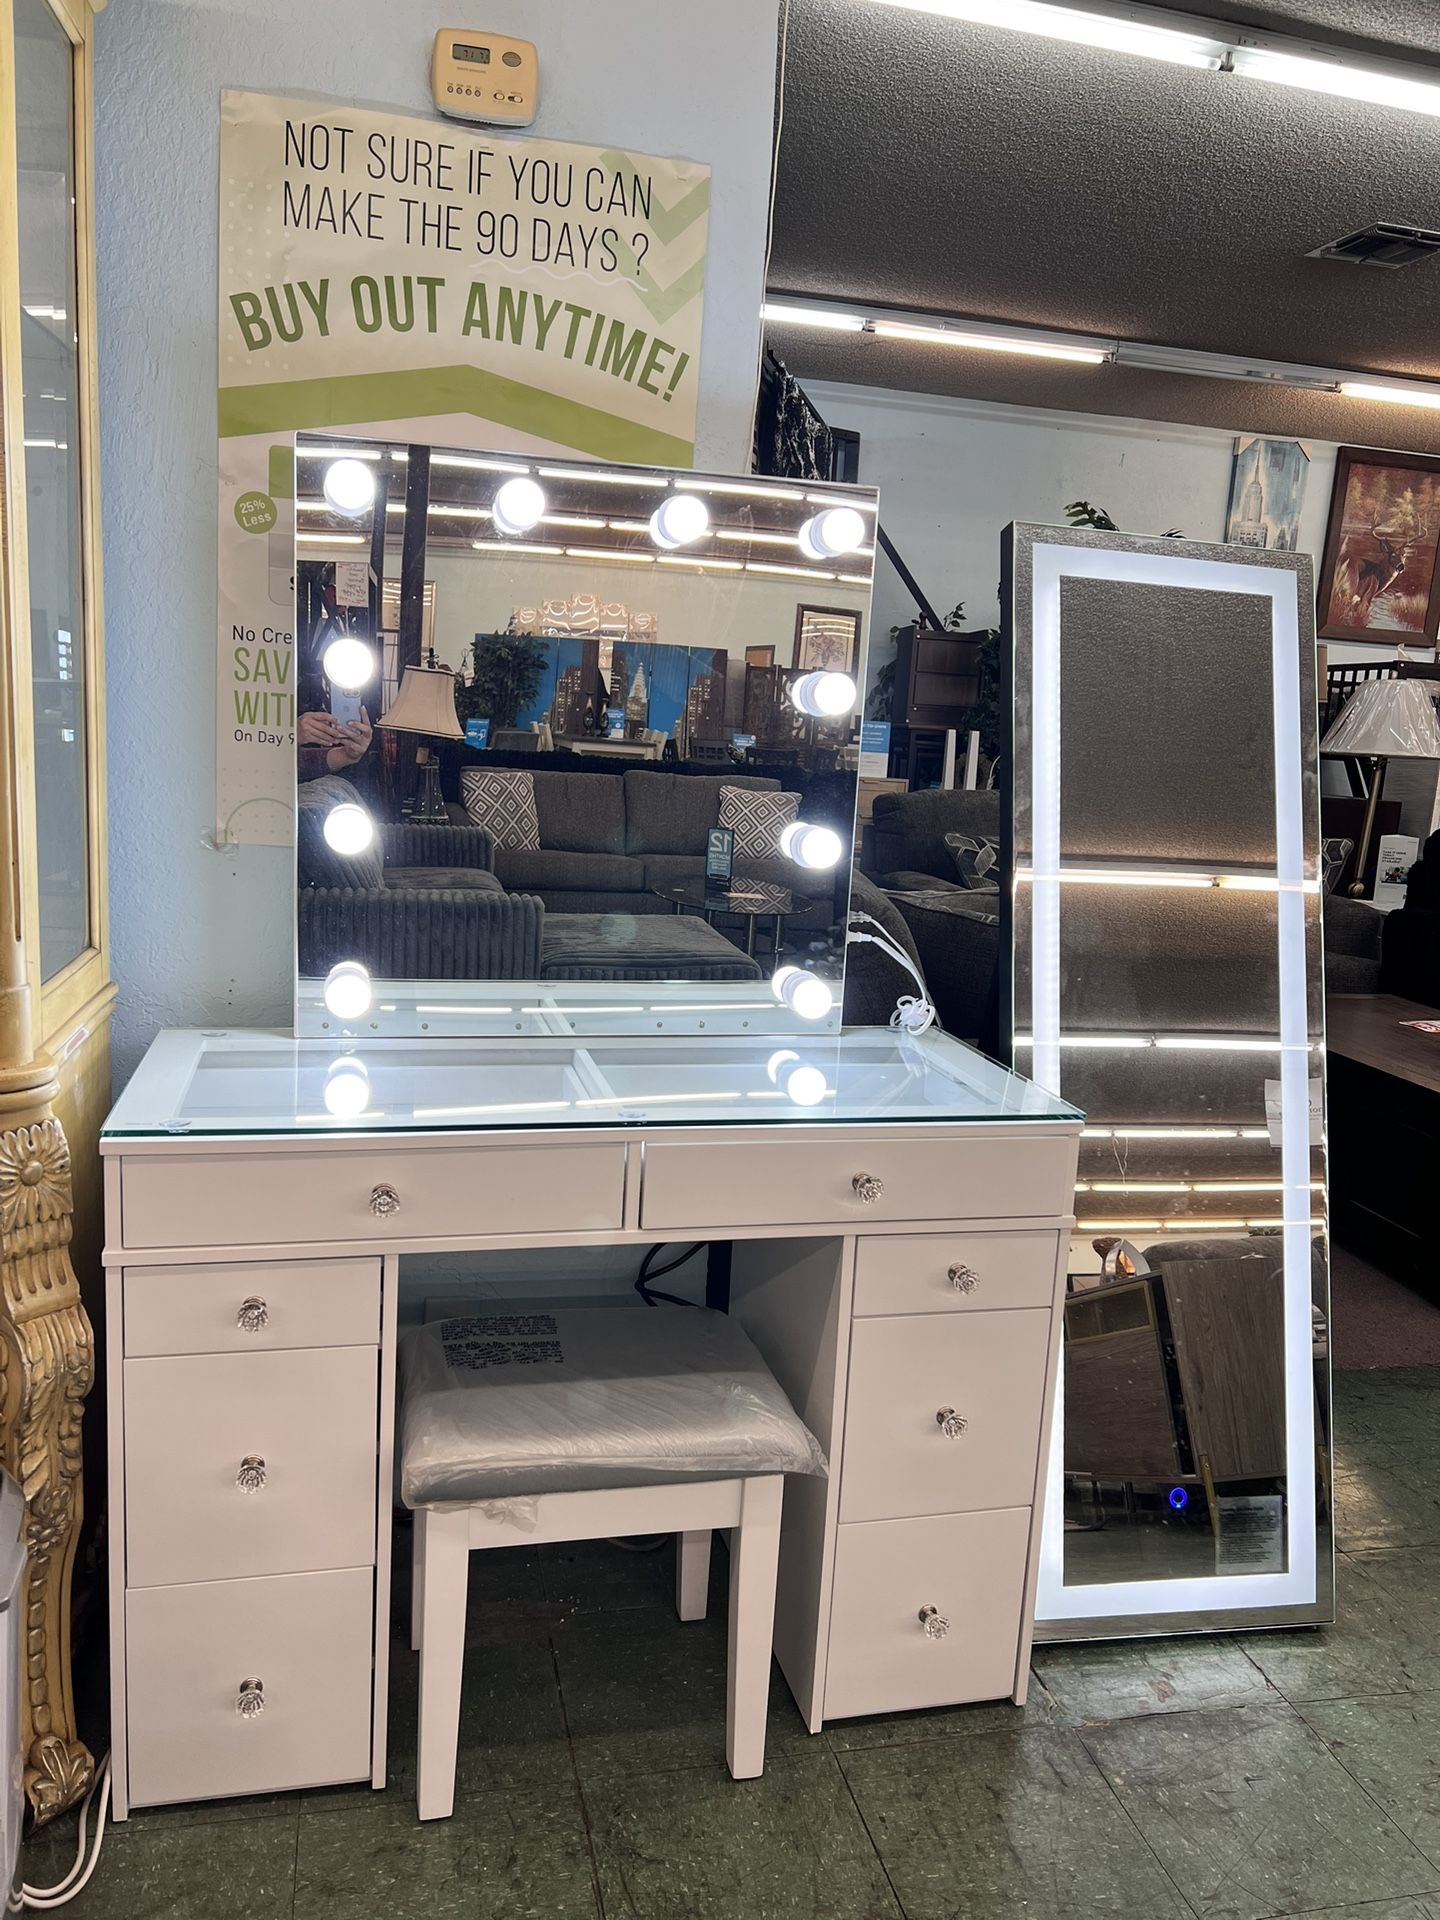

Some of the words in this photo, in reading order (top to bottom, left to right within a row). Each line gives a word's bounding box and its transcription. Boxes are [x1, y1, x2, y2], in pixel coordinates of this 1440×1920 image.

[285, 120, 354, 174] NOT
[367, 133, 455, 191] SURE
[468, 149, 494, 195] IF
[508, 155, 573, 208] YOU
[585, 168, 652, 220] CAN
[284, 181, 386, 240] MAKE
[399, 198, 464, 251] THE
[477, 210, 519, 258] 90
[531, 217, 619, 272] DAYS
[229, 278, 330, 352] BUY
[350, 275, 446, 334] OUT
[461, 281, 690, 403] ANYTIME!
[240, 498, 266, 514] 25%
[242, 512, 272, 528] Less
[232, 624, 256, 642] No
[234, 689, 295, 727] WIT
[234, 729, 253, 742] On
[258, 730, 284, 747] Day
